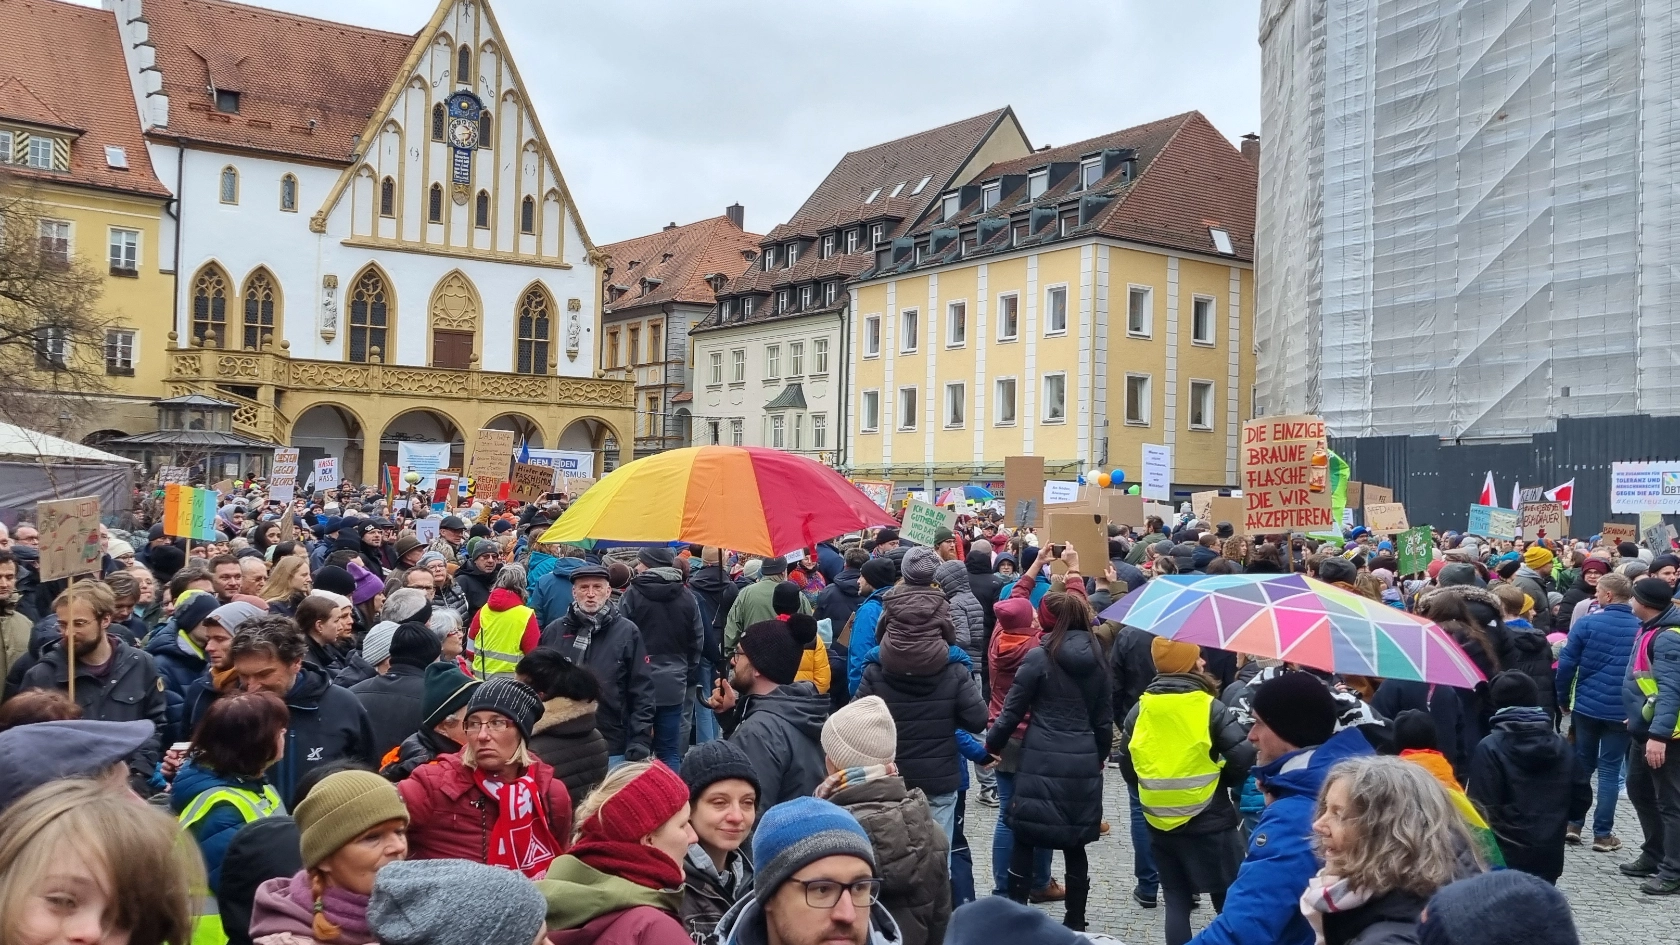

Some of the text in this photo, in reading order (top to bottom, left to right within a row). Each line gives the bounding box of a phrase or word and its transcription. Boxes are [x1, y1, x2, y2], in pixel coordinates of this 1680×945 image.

[1244, 422, 1324, 444] DIE EINZIGE
[1247, 445, 1307, 465] BRAUNE
[273, 466, 296, 474] GEGEN
[1246, 466, 1307, 488] FLASCHE
[272, 478, 295, 486] RECHTS
[516, 472, 552, 486] FASCHISMUS
[1246, 489, 1310, 510] DIE WIR
[1521, 489, 1539, 500] KEIN
[913, 504, 946, 521] ICH BIN EIN
[1245, 508, 1333, 530] AKZEPTIEREN.
[911, 514, 943, 528] GUTMENSC
[911, 522, 922, 530] UND
[908, 530, 925, 542] AUCH
